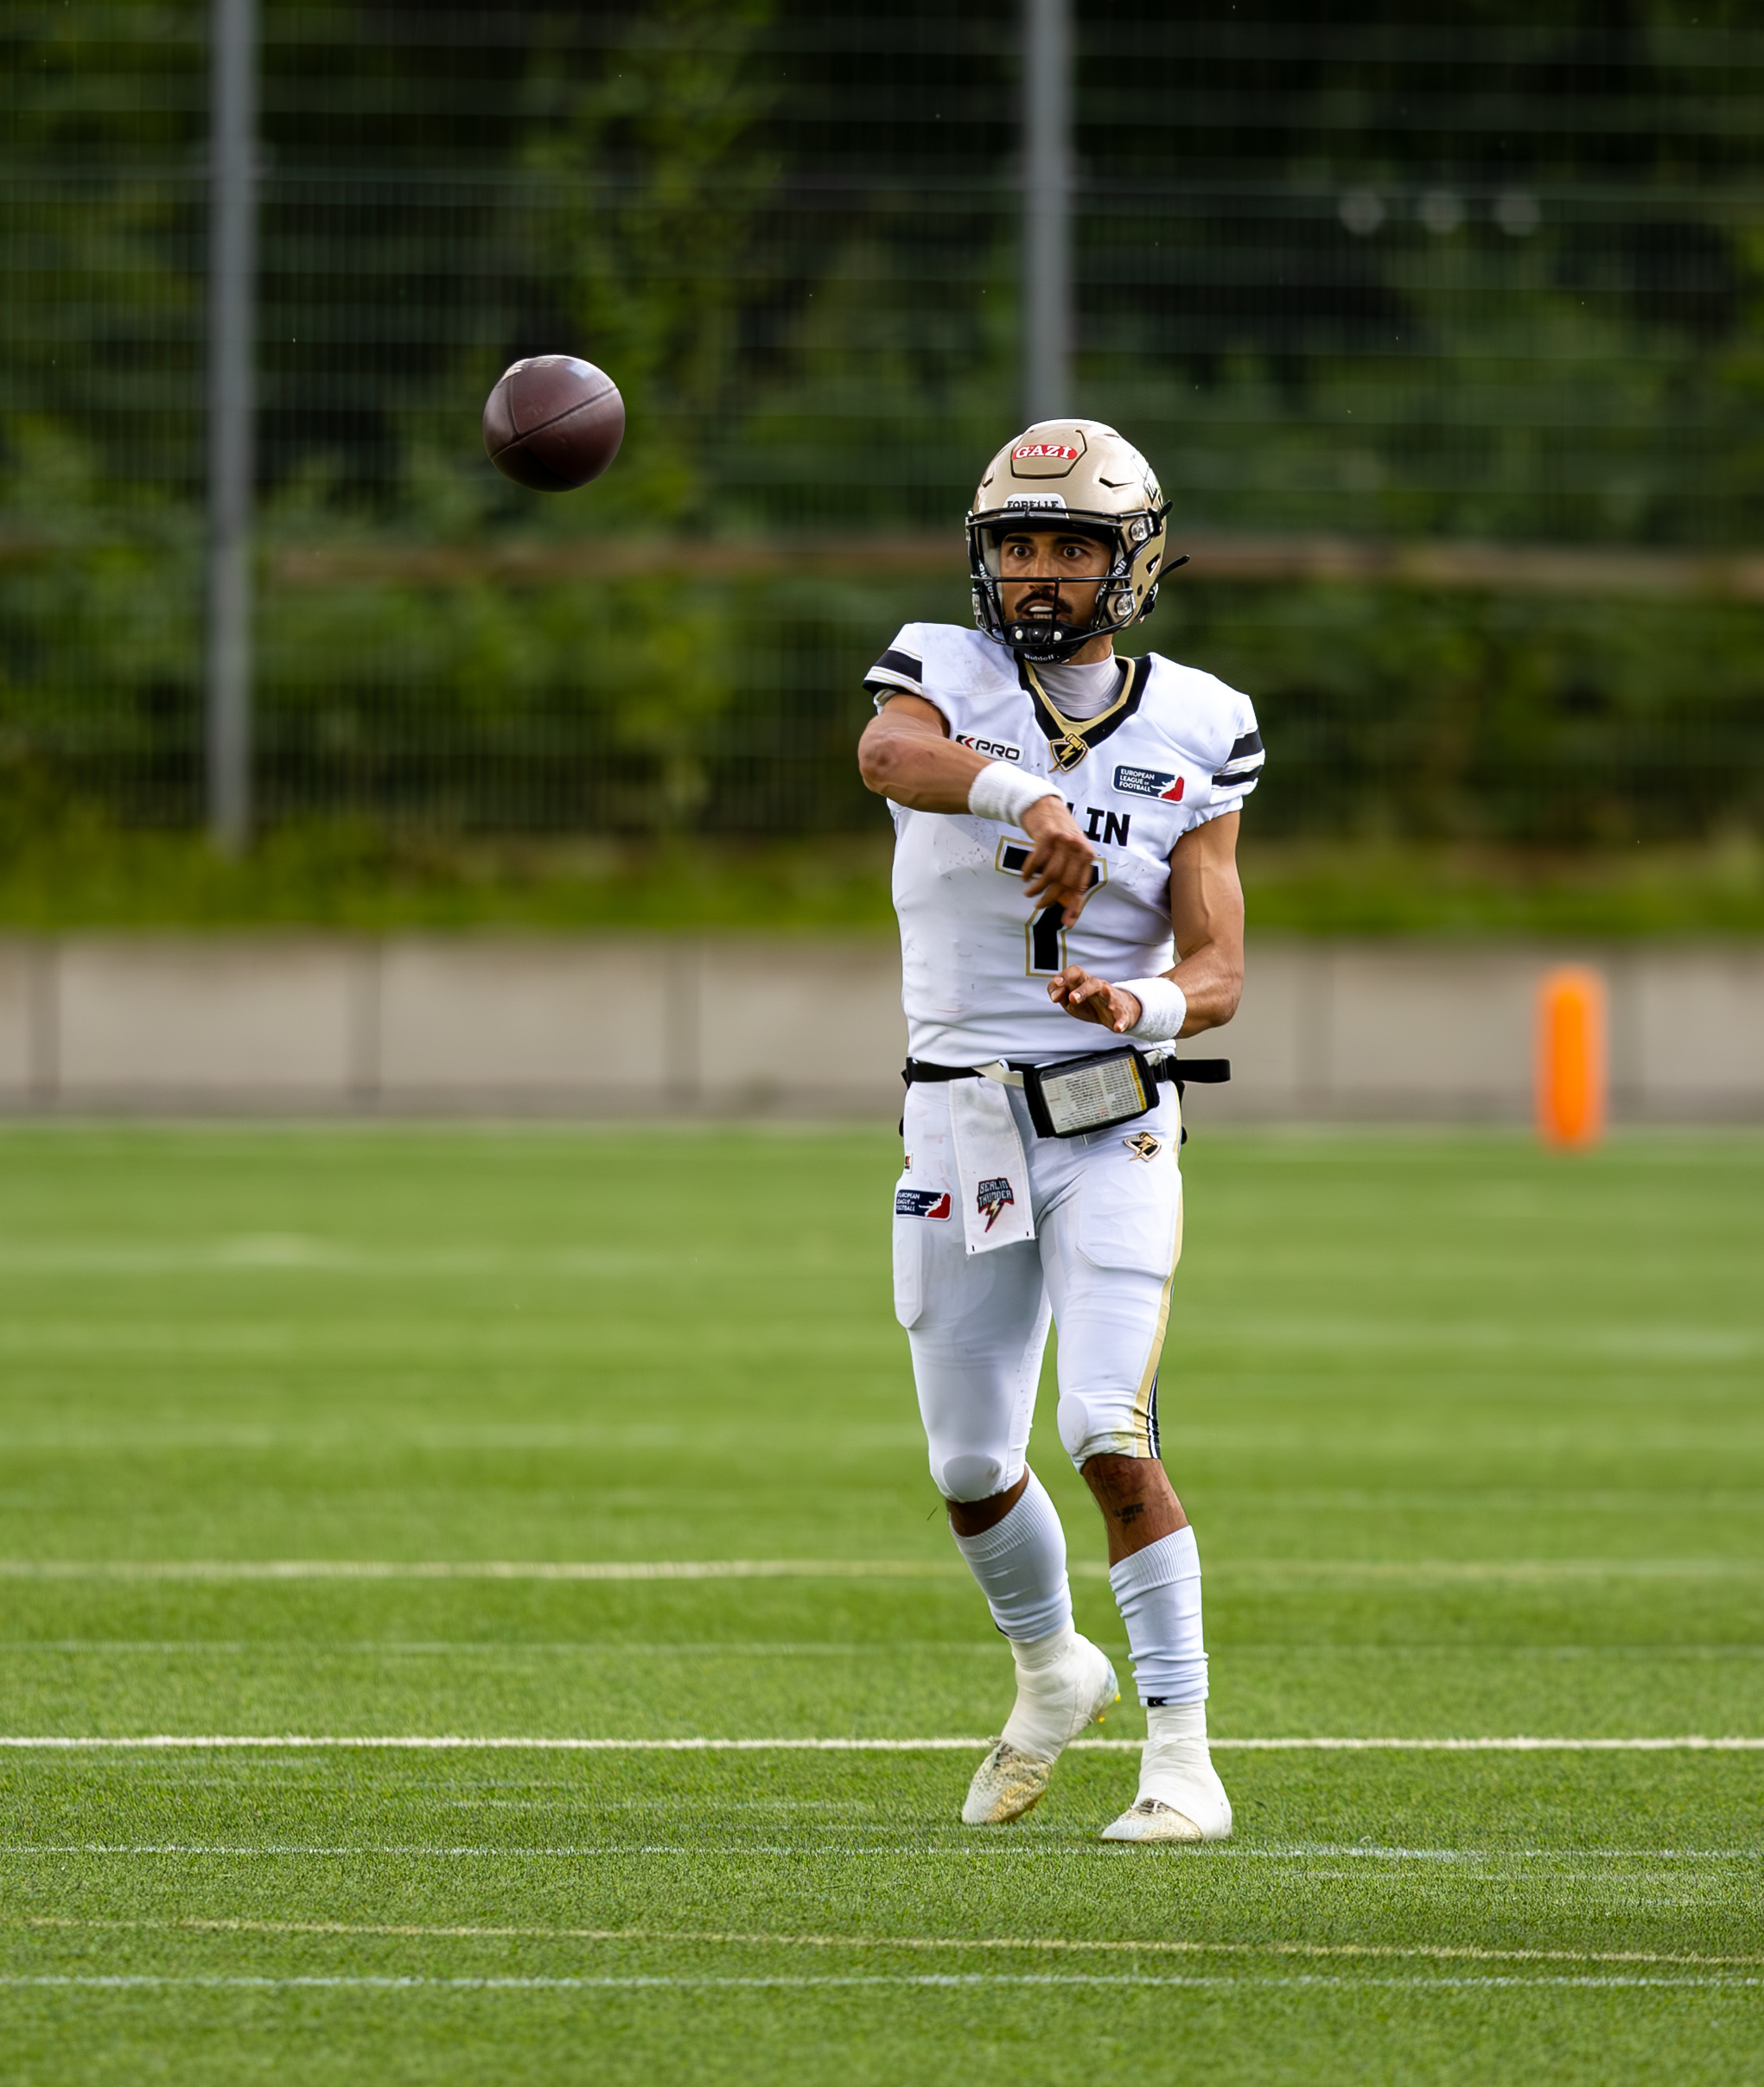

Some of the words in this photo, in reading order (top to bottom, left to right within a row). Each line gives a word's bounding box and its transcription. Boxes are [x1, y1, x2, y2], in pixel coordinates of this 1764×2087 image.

[1119, 774, 1143, 785] LEAGUE
[1120, 768, 1155, 780] EUROPEAN
[1119, 780, 1151, 792] FOOTBALL
[995, 835, 1109, 977] 7
